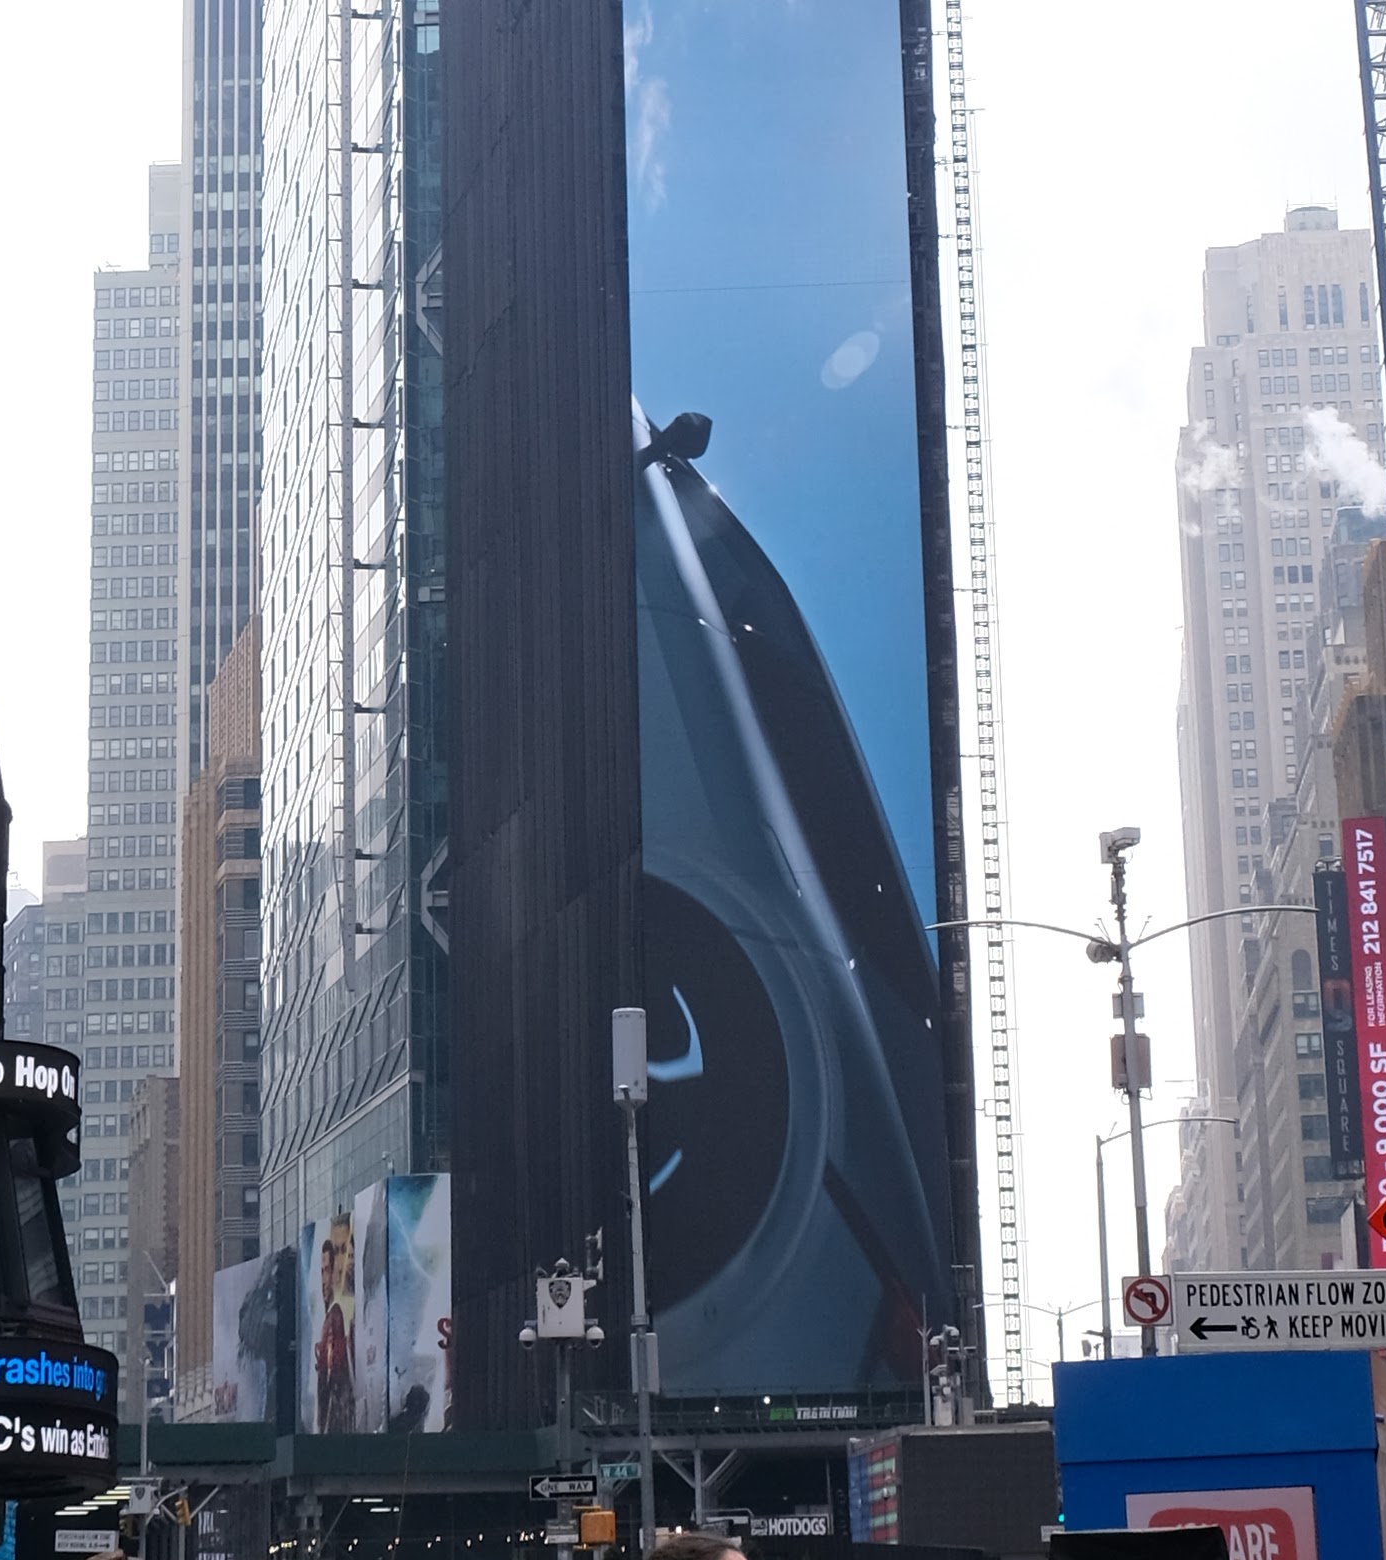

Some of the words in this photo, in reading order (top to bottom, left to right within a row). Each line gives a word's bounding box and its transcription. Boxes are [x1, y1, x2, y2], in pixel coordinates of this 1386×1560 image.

[1355, 828, 1376, 875] 7517
[1359, 880, 1378, 916] 841
[1362, 920, 1381, 955] 212
[1364, 965, 1374, 1001] LEASING
[1374, 962, 1386, 1027] INFORMATION
[1325, 880, 1339, 971] TIMES
[1336, 1039, 1350, 1153] SQUARE
[1365, 1002, 1376, 1027] FOR
[15, 1055, 59, 1098] Hop
[1187, 1283, 1300, 1307] PEDESTRIAN
[1305, 1282, 1355, 1305] FLOW
[1289, 1314, 1334, 1338] KEEP
[73, 1357, 95, 1391] into
[40, 1420, 70, 1455] win
[70, 1429, 85, 1457] as
[86, 1421, 110, 1461] Embi
[541, 1482, 559, 1492] ONE
[569, 1481, 589, 1491] WAY
[769, 1516, 826, 1536] HOTDOGS
